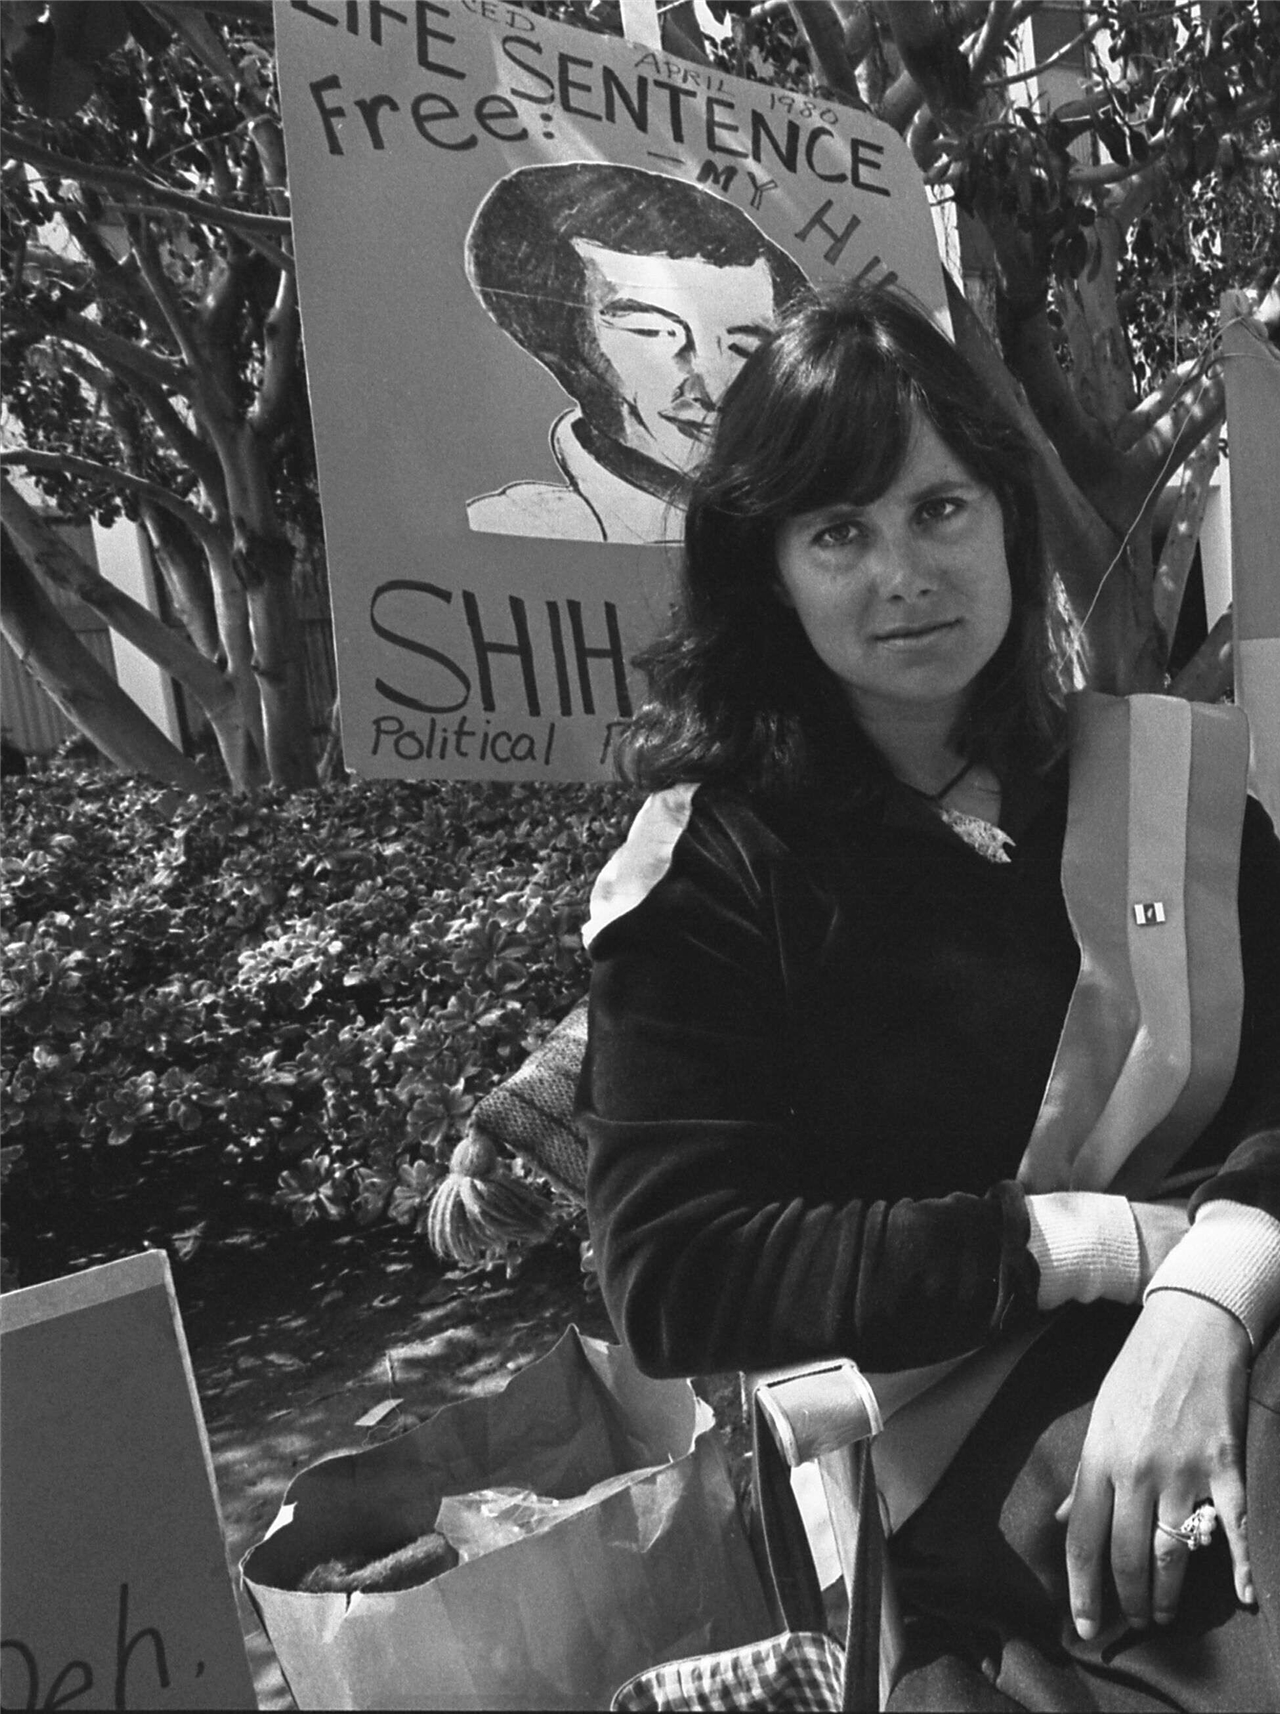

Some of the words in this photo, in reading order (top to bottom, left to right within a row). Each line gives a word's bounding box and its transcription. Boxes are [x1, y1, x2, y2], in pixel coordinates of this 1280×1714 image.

[309, 74, 555, 156] Free:
[501, 35, 891, 198] SENTENCE
[634, 52, 735, 97] APRIL
[770, 93, 839, 125] 1980
[695, 159, 779, 211] MY
[371, 580, 633, 718] SHIH
[372, 716, 555, 766] Political
